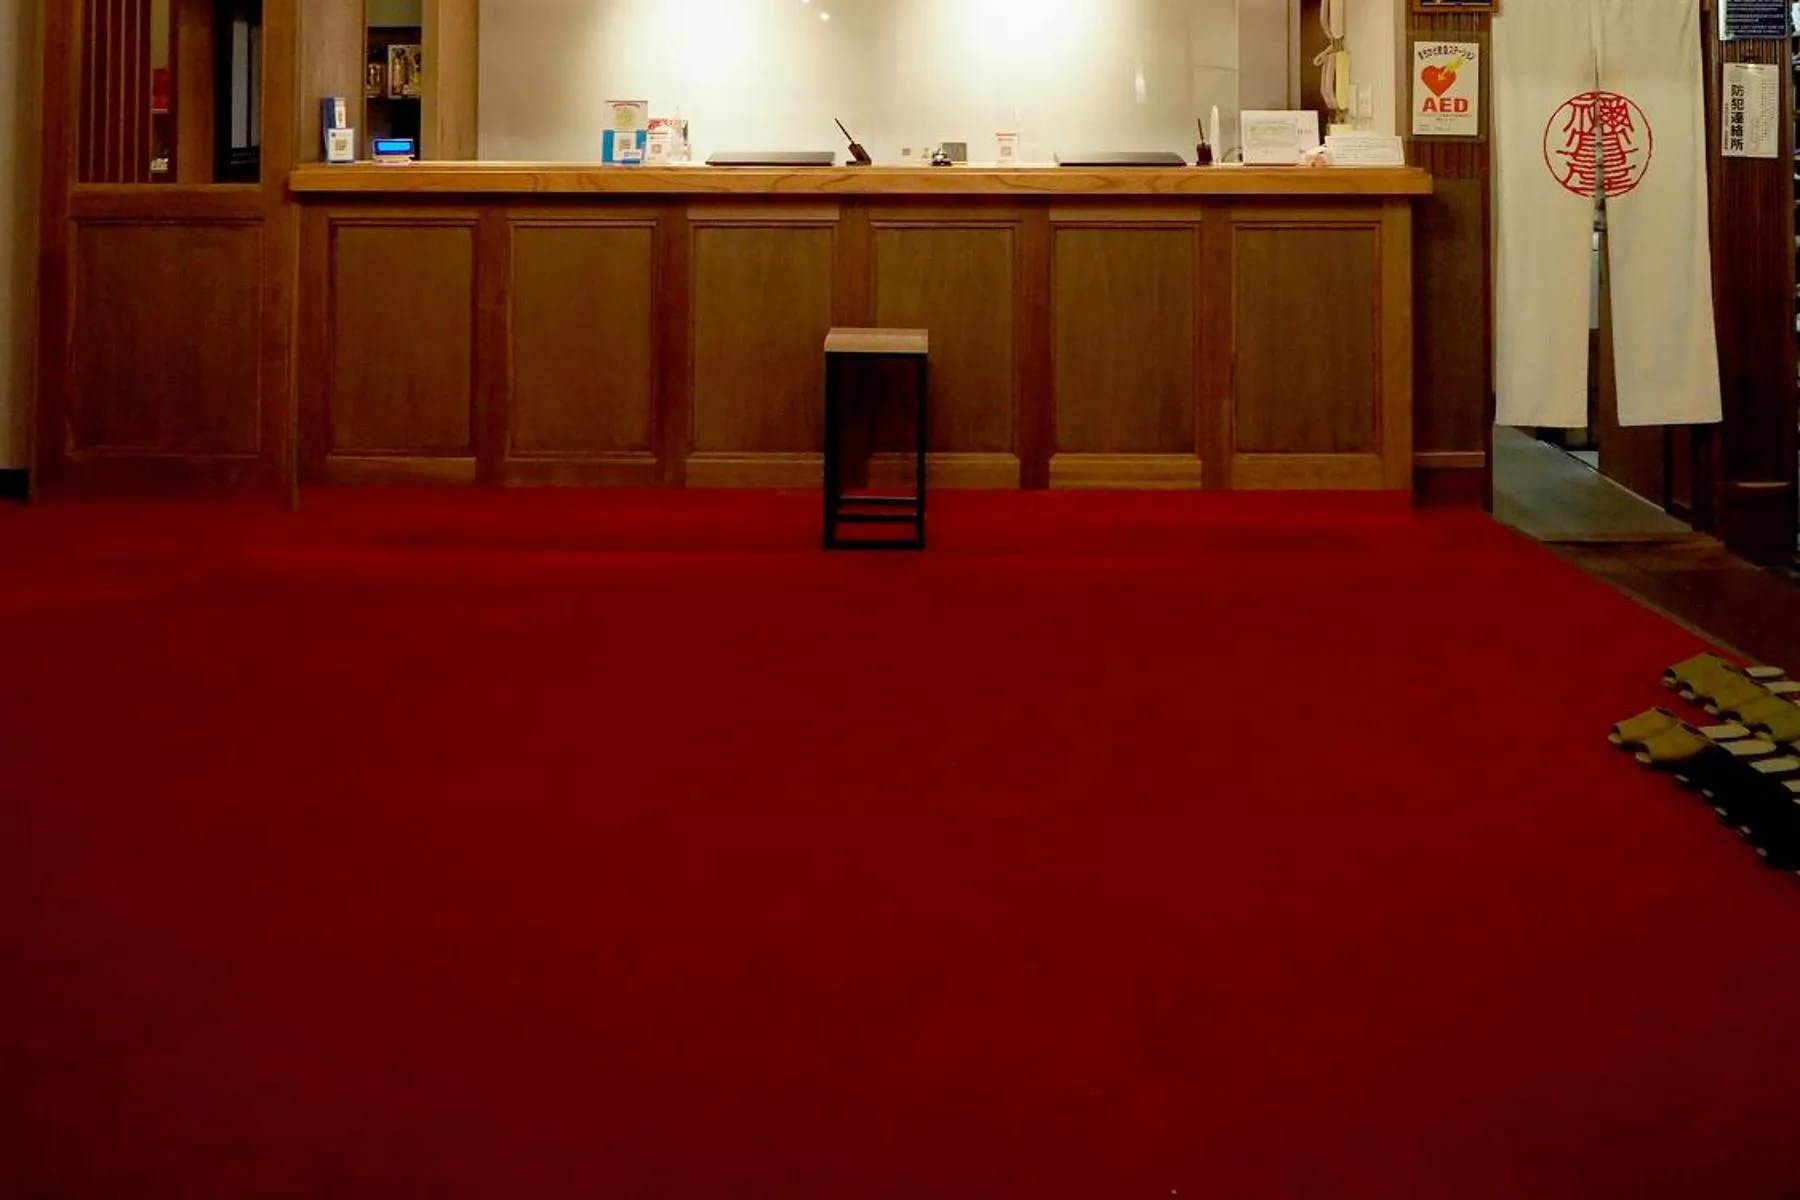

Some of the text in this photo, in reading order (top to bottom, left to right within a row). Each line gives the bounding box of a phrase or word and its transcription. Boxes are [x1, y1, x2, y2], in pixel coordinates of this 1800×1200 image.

[1422, 97, 1469, 113] AED
[1730, 84, 1745, 151] 防犯連絡所
